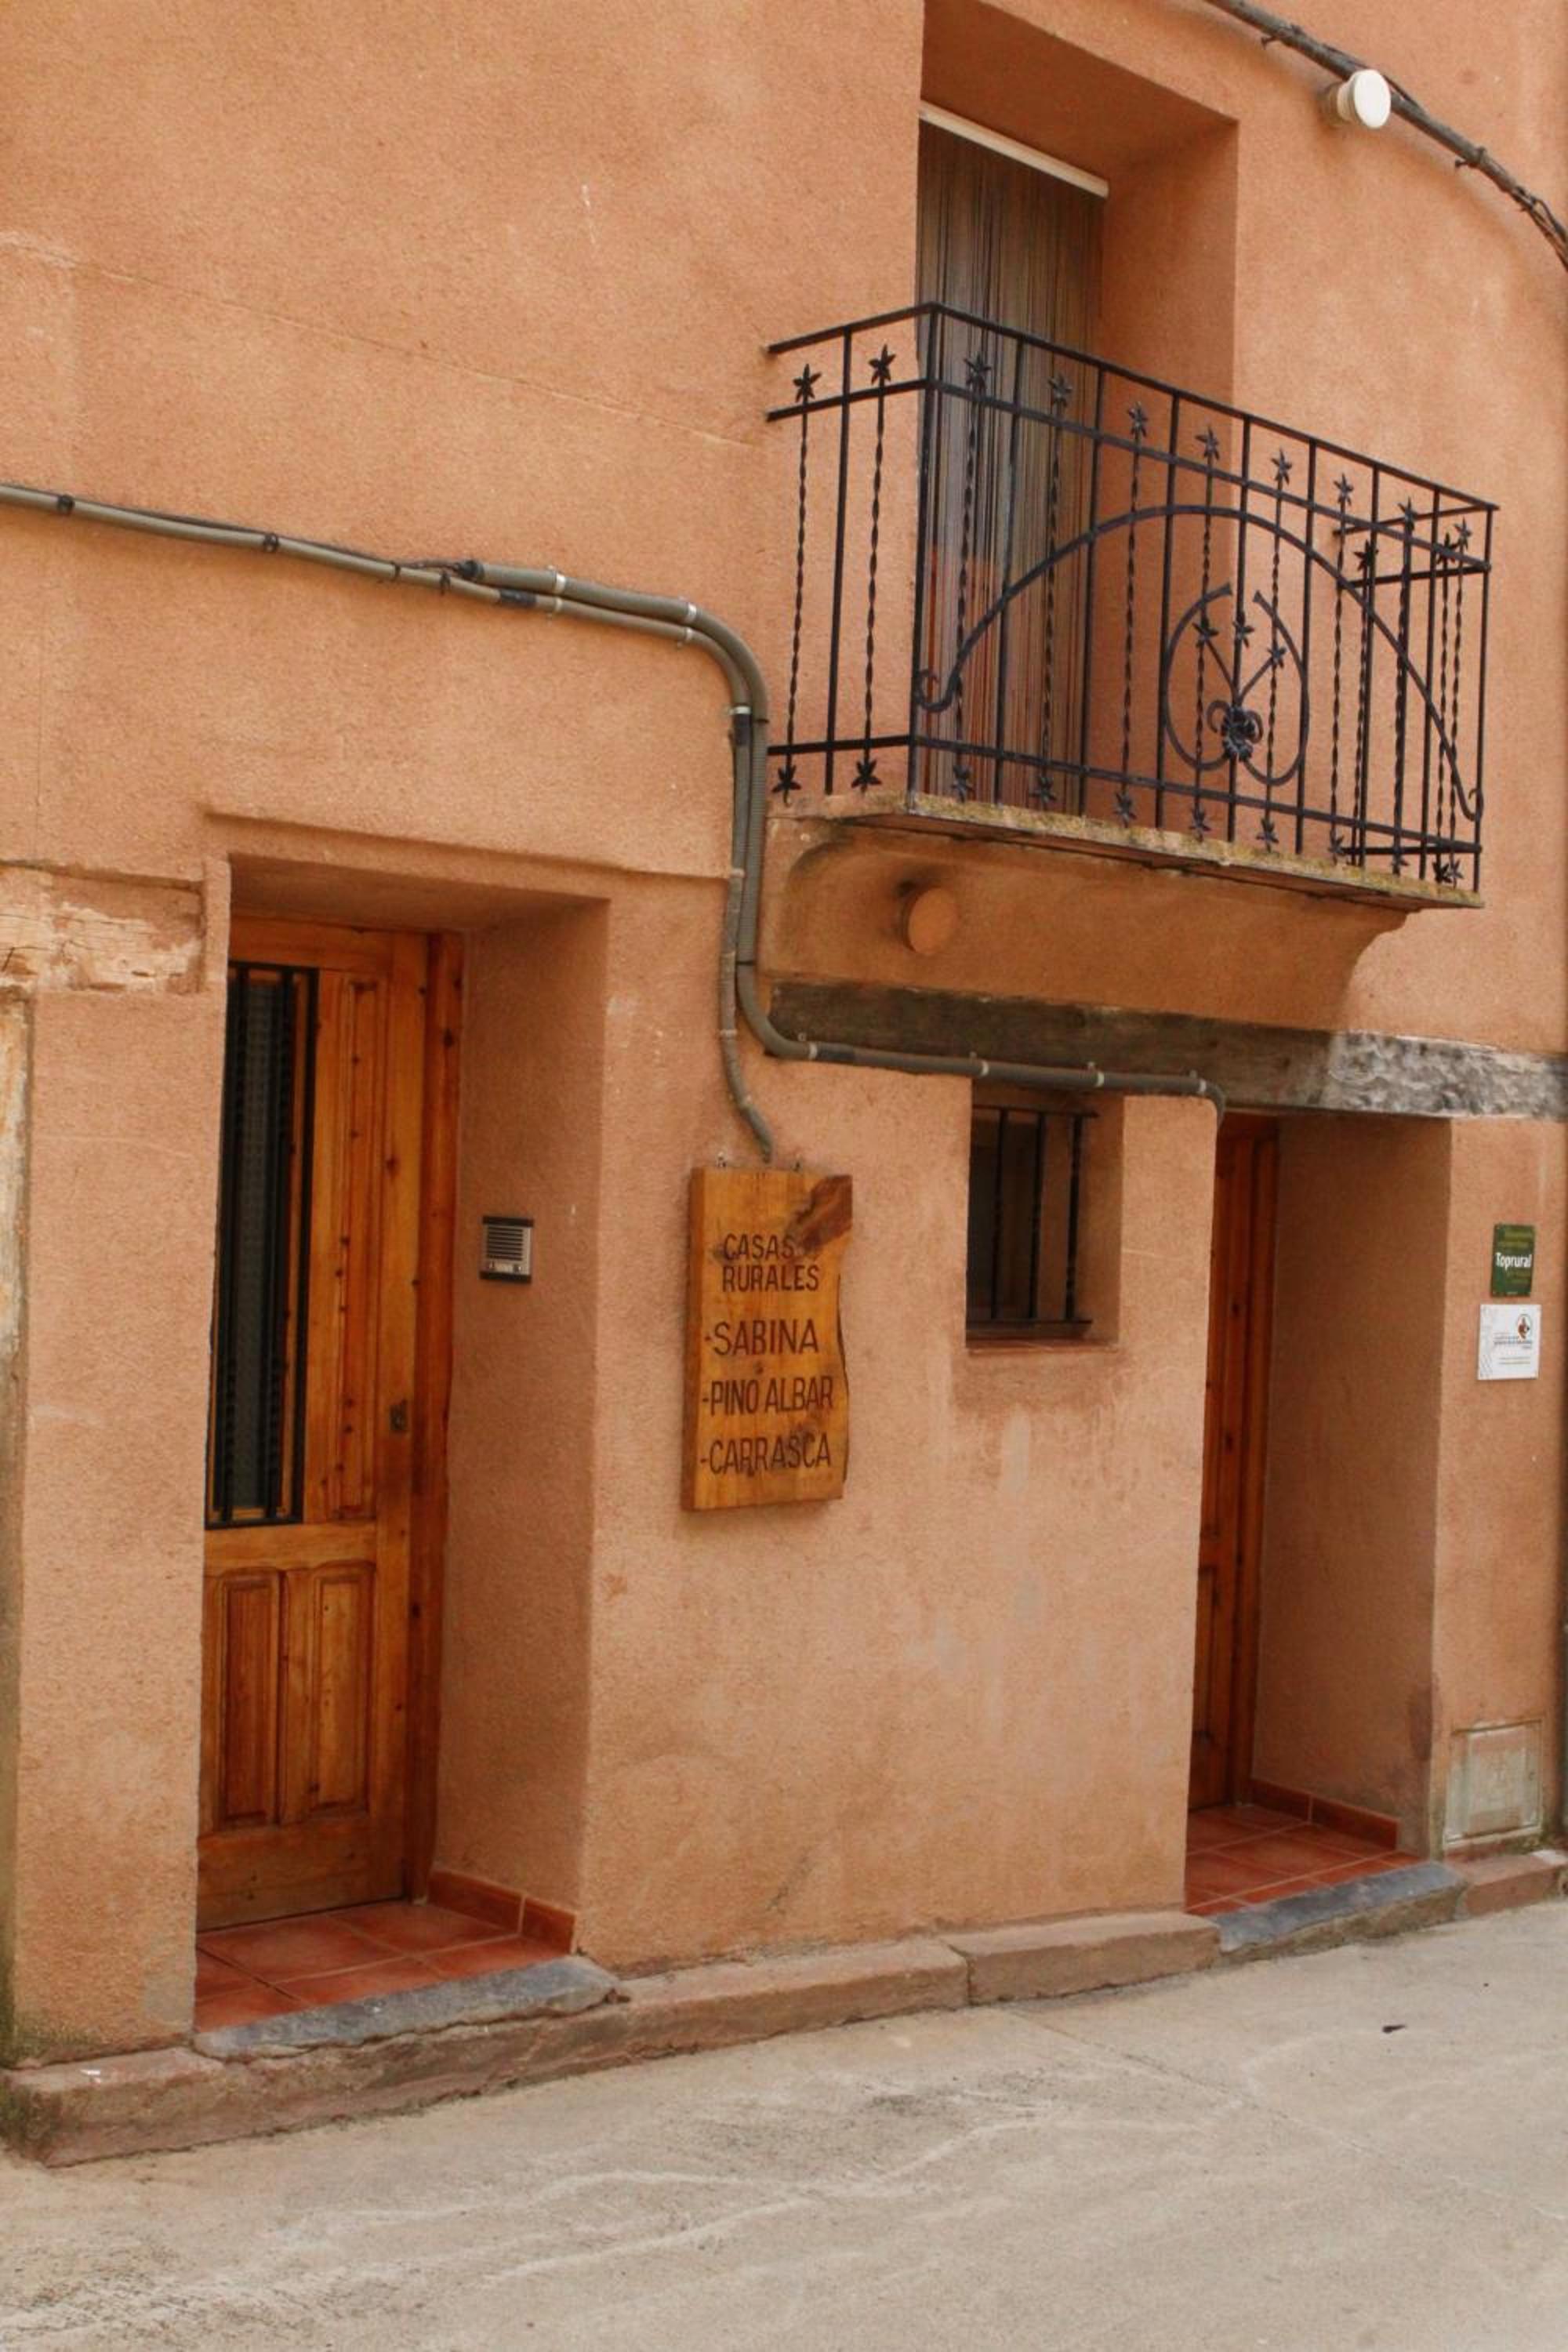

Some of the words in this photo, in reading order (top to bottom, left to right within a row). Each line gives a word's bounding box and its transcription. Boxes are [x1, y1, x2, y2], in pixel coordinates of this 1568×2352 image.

[723, 1233, 795, 1261] CASAS
[1496, 1252, 1532, 1270] Toprural
[722, 1265, 819, 1293] RURALES
[765, 1376, 833, 1411] ALBAR
